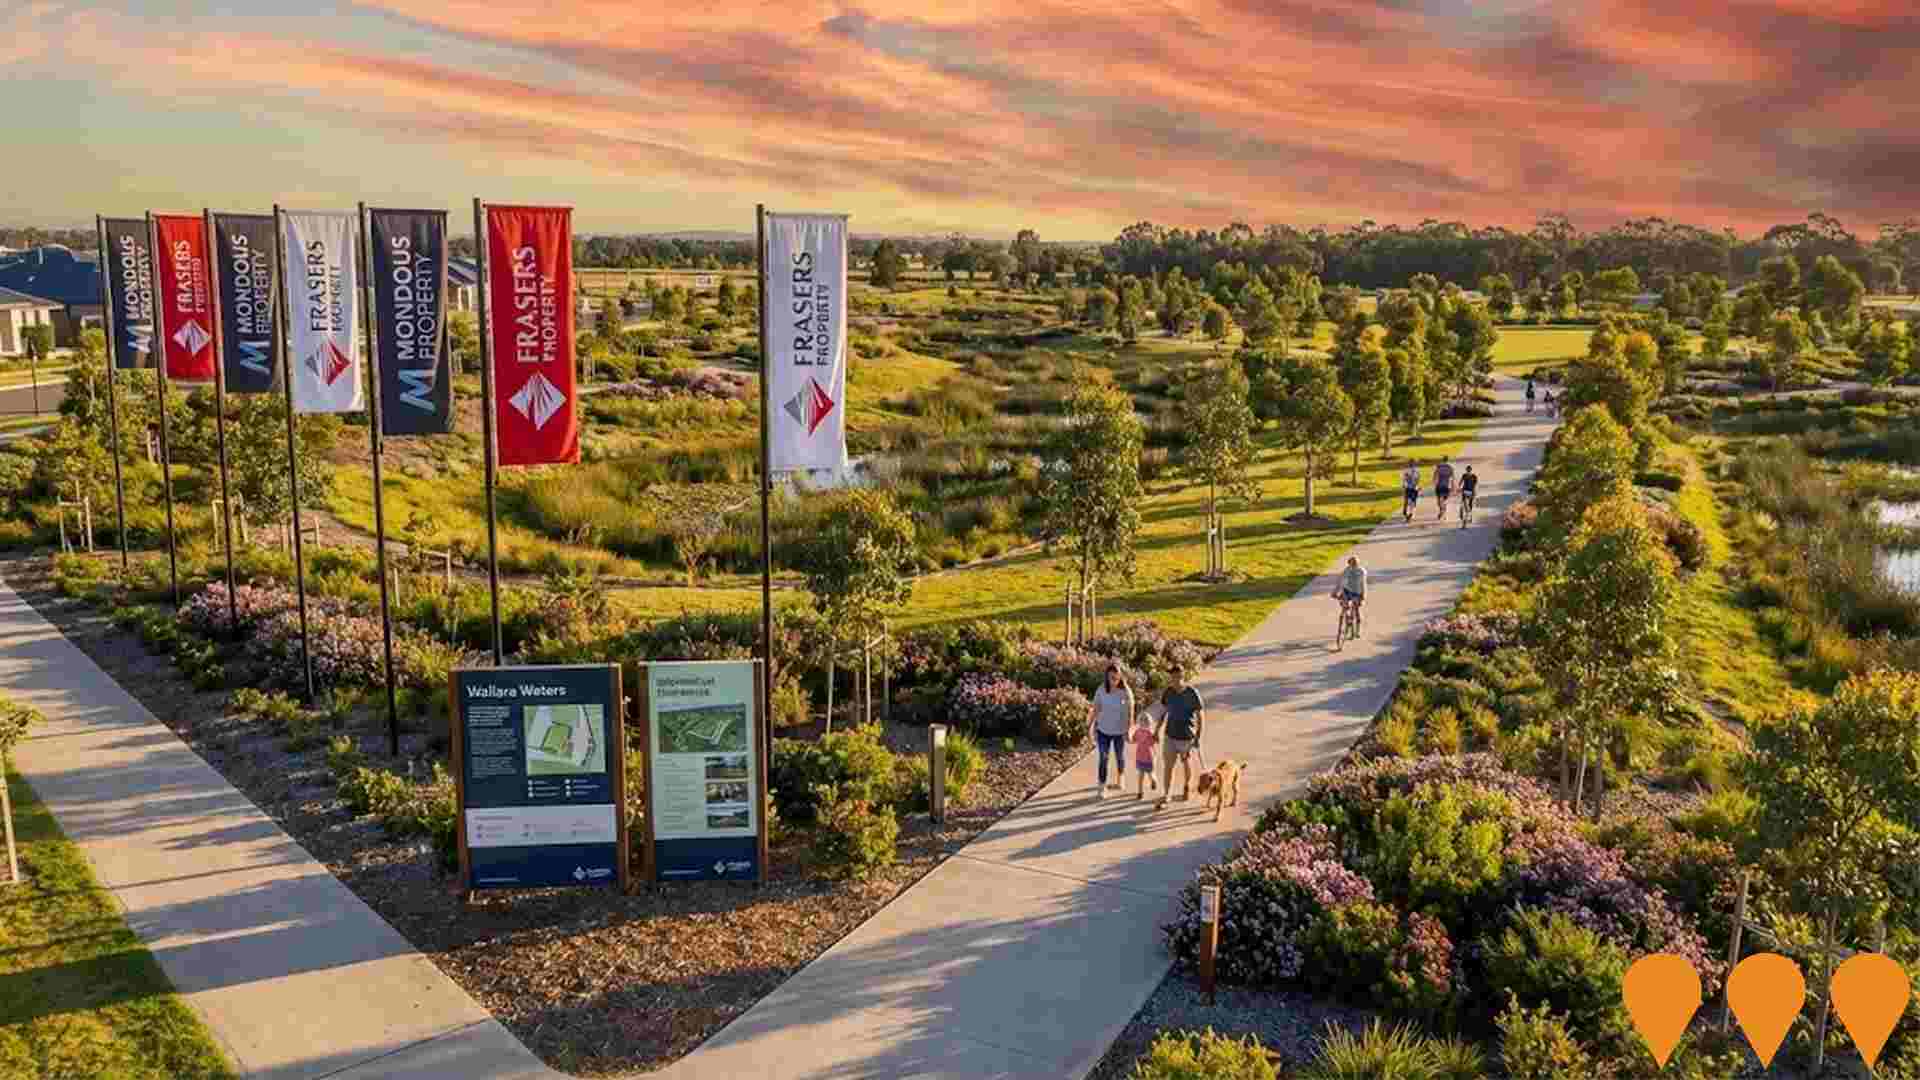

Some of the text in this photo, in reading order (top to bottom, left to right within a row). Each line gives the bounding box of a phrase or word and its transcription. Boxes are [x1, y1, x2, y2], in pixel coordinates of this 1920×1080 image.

[173, 240, 194, 313] FRASERS
[232, 234, 255, 334] MONDOUS
[304, 240, 328, 332] FRASERS
[392, 235, 415, 360] MONDOUS
[415, 253, 437, 360] PROPERTY
[513, 246, 540, 363] FRASERS
[792, 251, 814, 366] FRASERS
